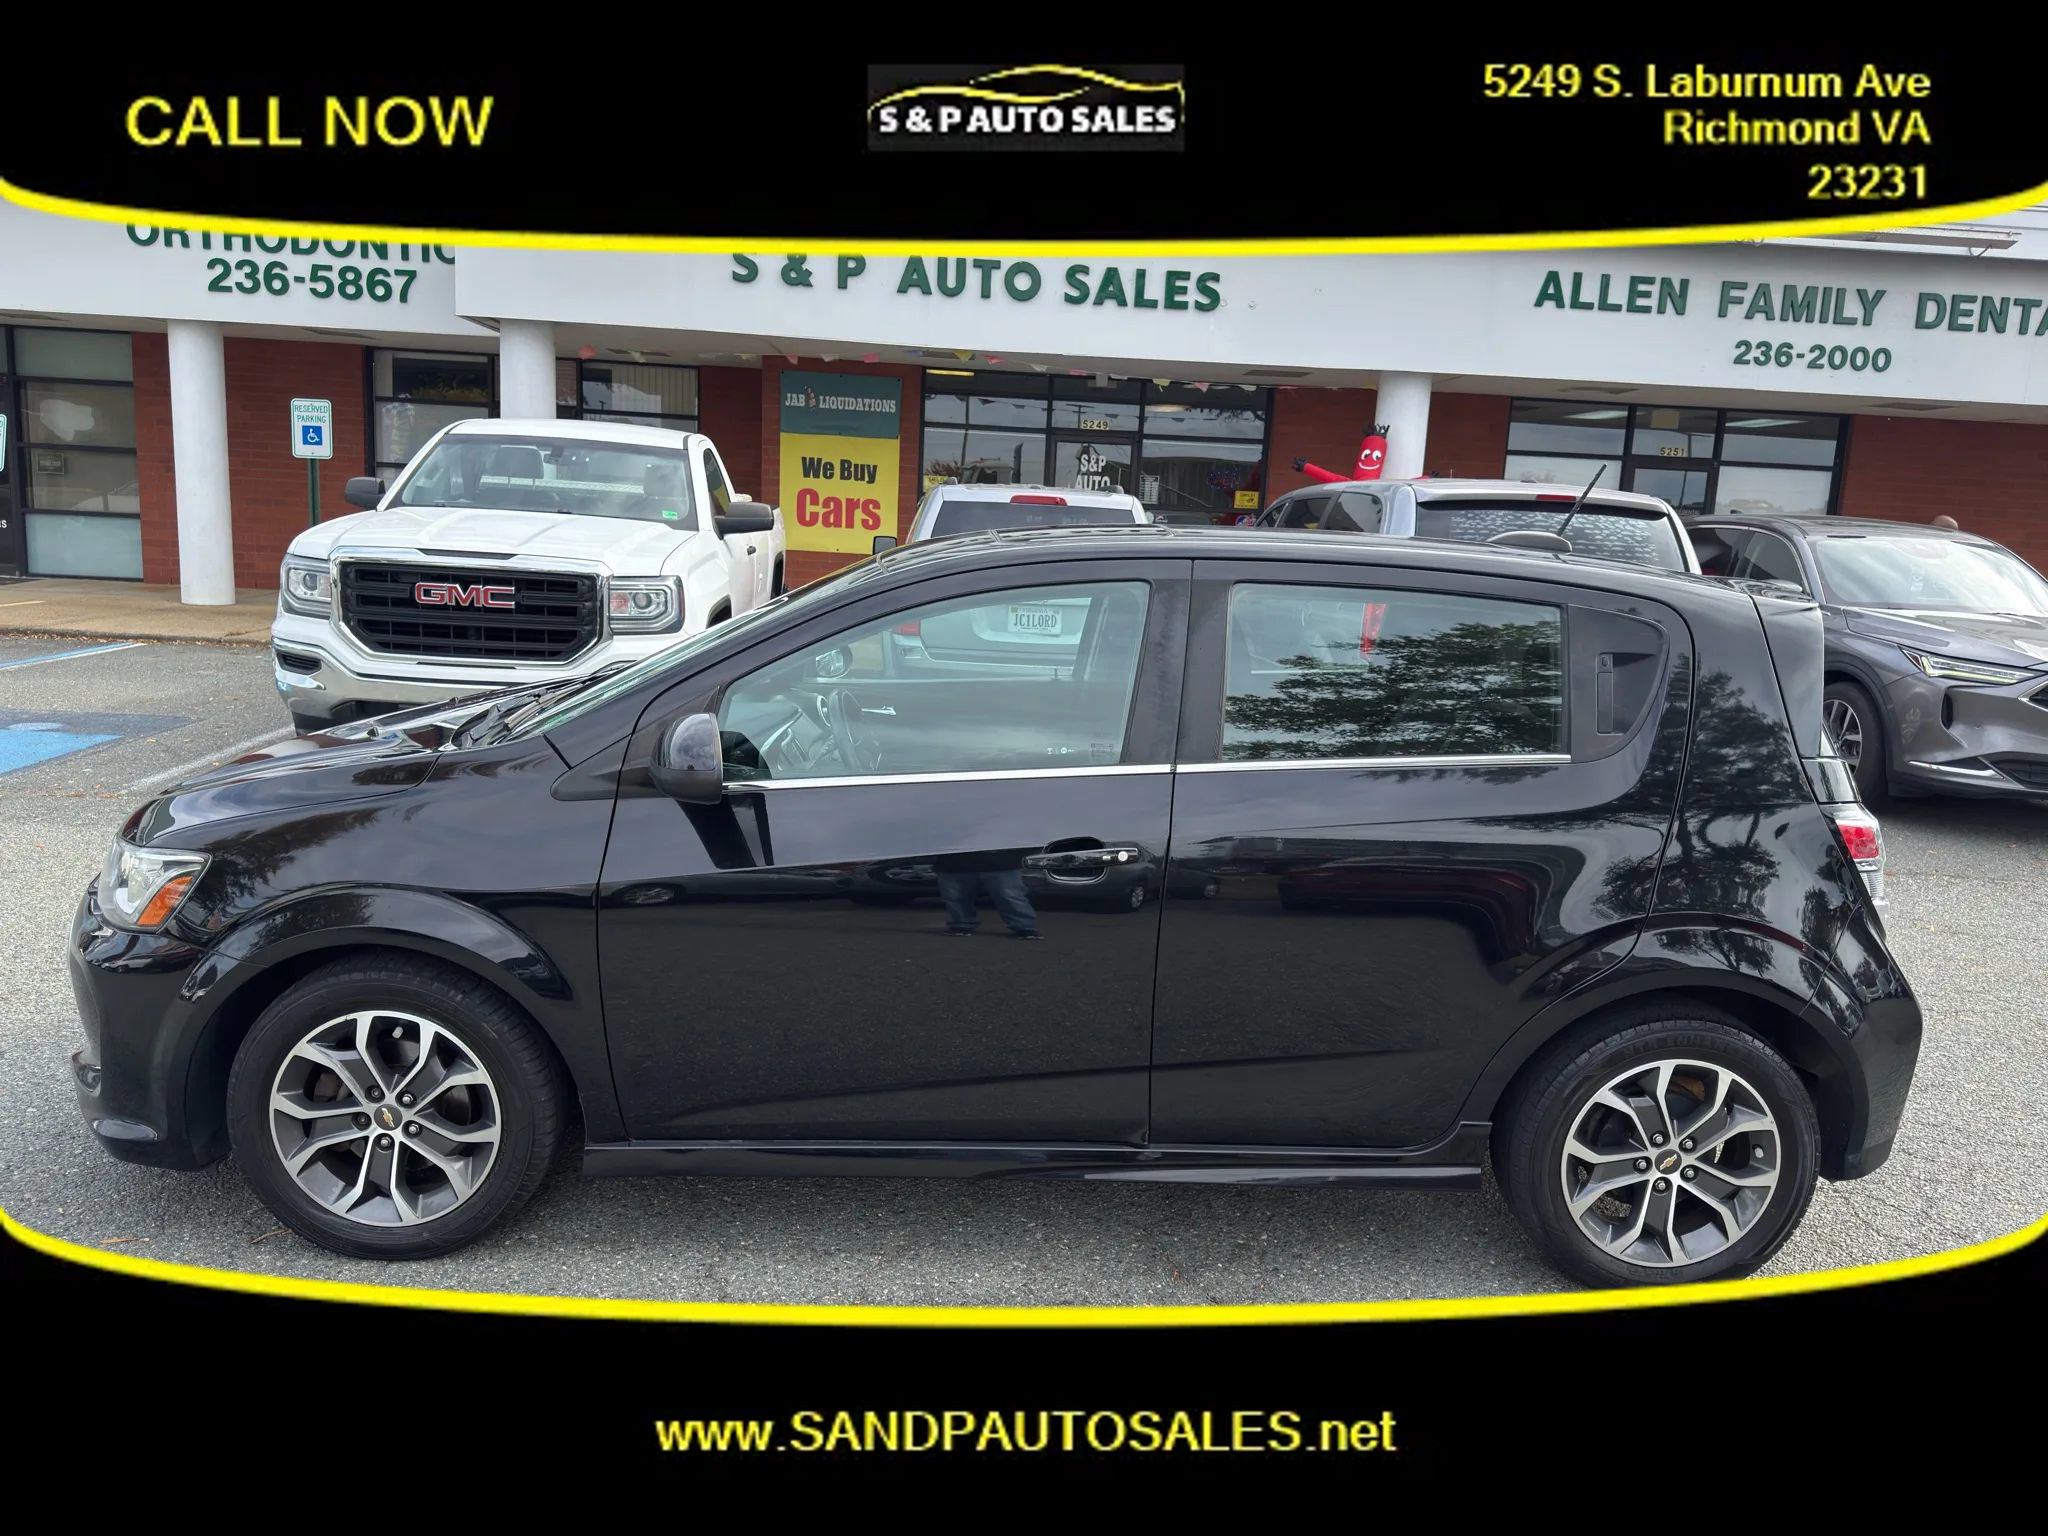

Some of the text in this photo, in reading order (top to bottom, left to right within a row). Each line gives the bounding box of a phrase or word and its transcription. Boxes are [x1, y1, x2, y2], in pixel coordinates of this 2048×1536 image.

[206, 257, 418, 305] 236-5867
[731, 251, 1222, 313] S & P AUTO SALES
[1533, 269, 1691, 317] ALLEN
[1717, 280, 1887, 327] FAMILY
[1732, 339, 1893, 374] 236-2000
[295, 405, 328, 413] RESERVED
[784, 392, 897, 414] JAB LIQUIDATIONS
[297, 415, 326, 423] PARKING
[1083, 420, 1108, 429] 5249
[1081, 454, 1106, 472] S&P
[1660, 447, 1685, 456] 5251
[801, 456, 878, 485] We Buy
[1075, 474, 1110, 491] AUTO
[796, 487, 882, 532] Cars
[415, 582, 516, 609] GMC
